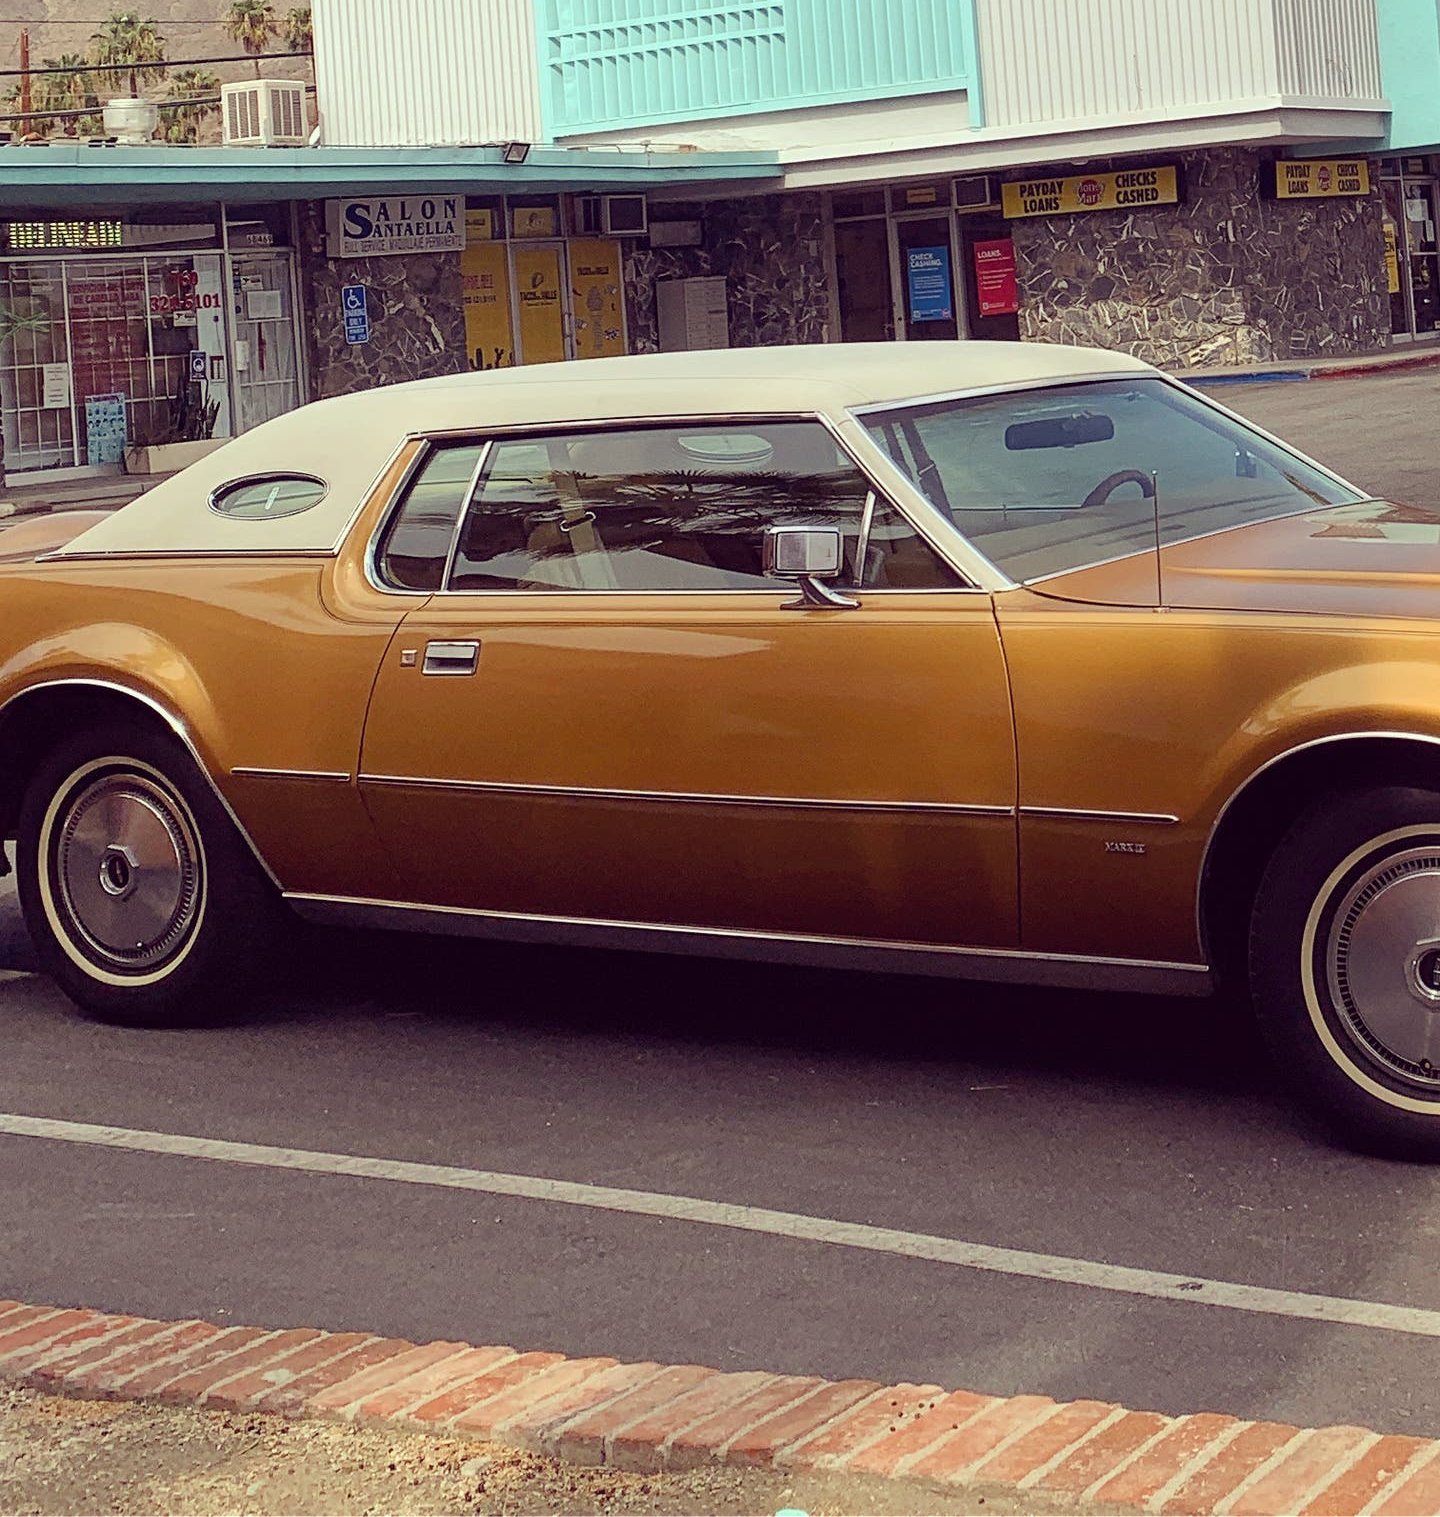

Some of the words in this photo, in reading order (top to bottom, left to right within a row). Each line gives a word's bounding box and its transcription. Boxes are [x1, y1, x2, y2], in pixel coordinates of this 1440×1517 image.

[1115, 171, 1157, 188] CHECKS
[1019, 181, 1064, 198] PAYDAY
[1116, 187, 1159, 204] CASHED
[1024, 197, 1060, 213] LOANS
[343, 199, 456, 239] SALON
